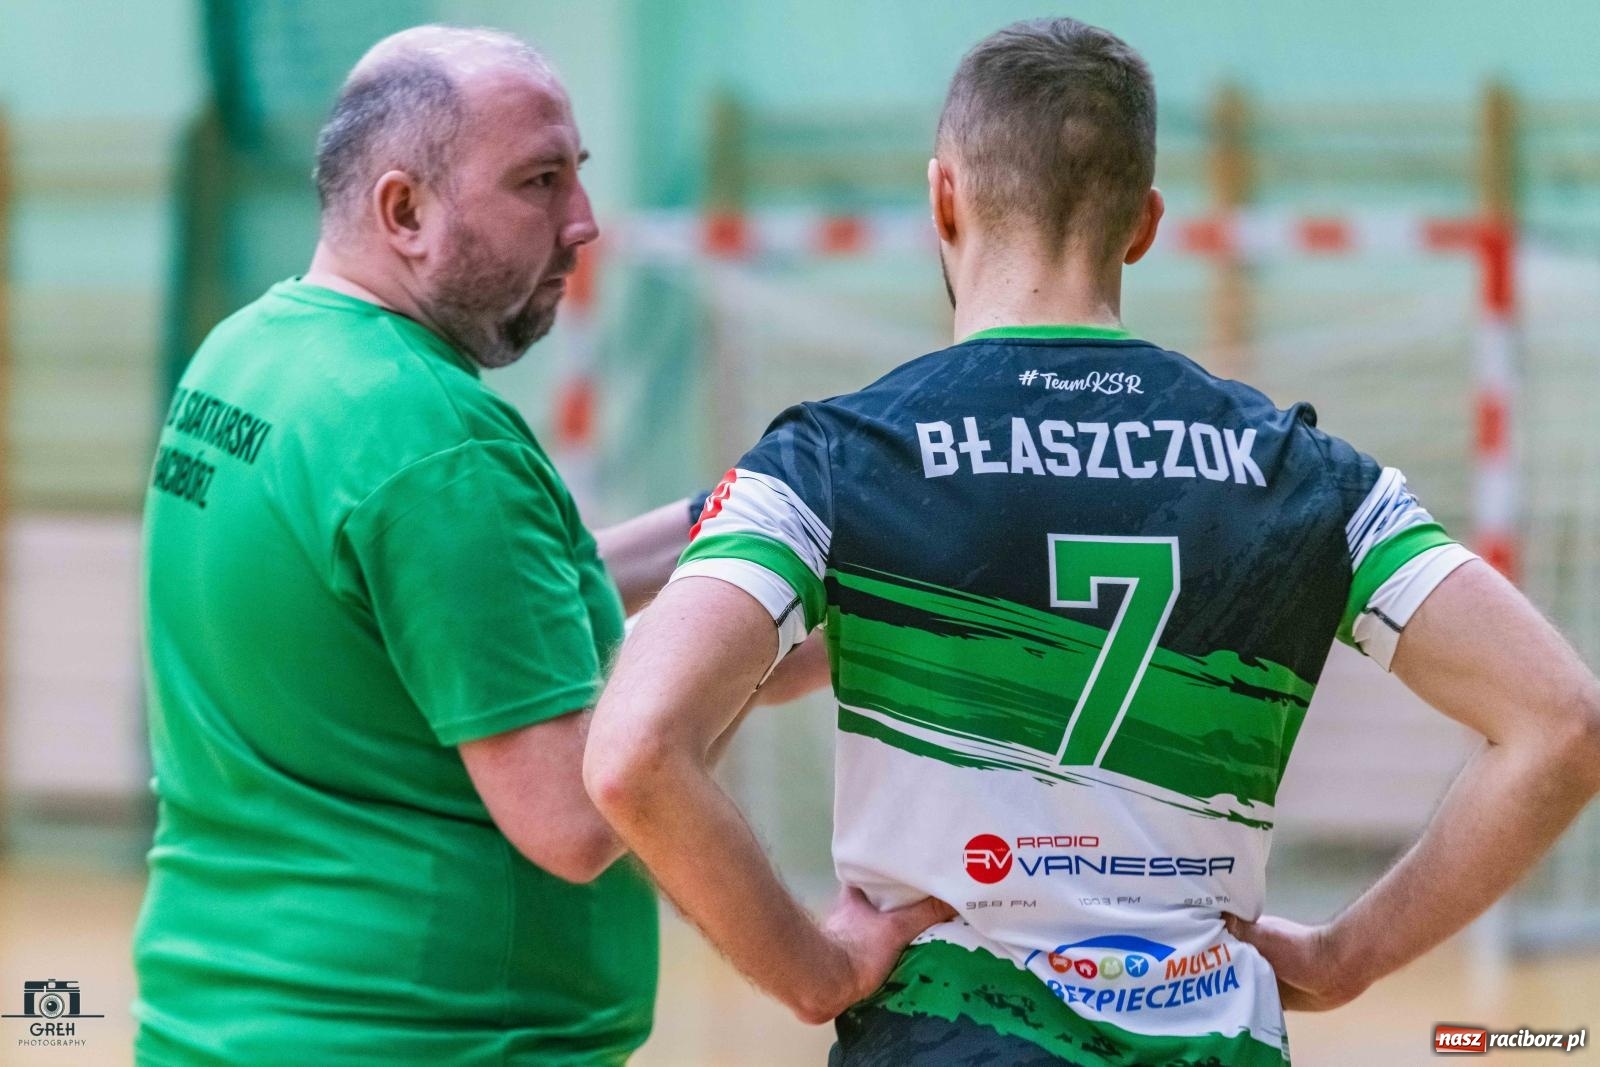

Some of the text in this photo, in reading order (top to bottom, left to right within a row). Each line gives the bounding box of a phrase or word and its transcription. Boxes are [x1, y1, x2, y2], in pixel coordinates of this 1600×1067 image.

[1018, 369, 1145, 395] #TeamKSR
[915, 416, 1267, 487] BŁASZCZOK
[1047, 533, 1181, 768] 7
[1017, 836, 1100, 848] RADIO
[1018, 856, 1235, 876] VANESSA
[1011, 900, 1037, 908] FM
[1117, 896, 1141, 904] FM
[1164, 943, 1231, 980] MULTI
[1047, 965, 1240, 1012] BEZPIECZENIA
